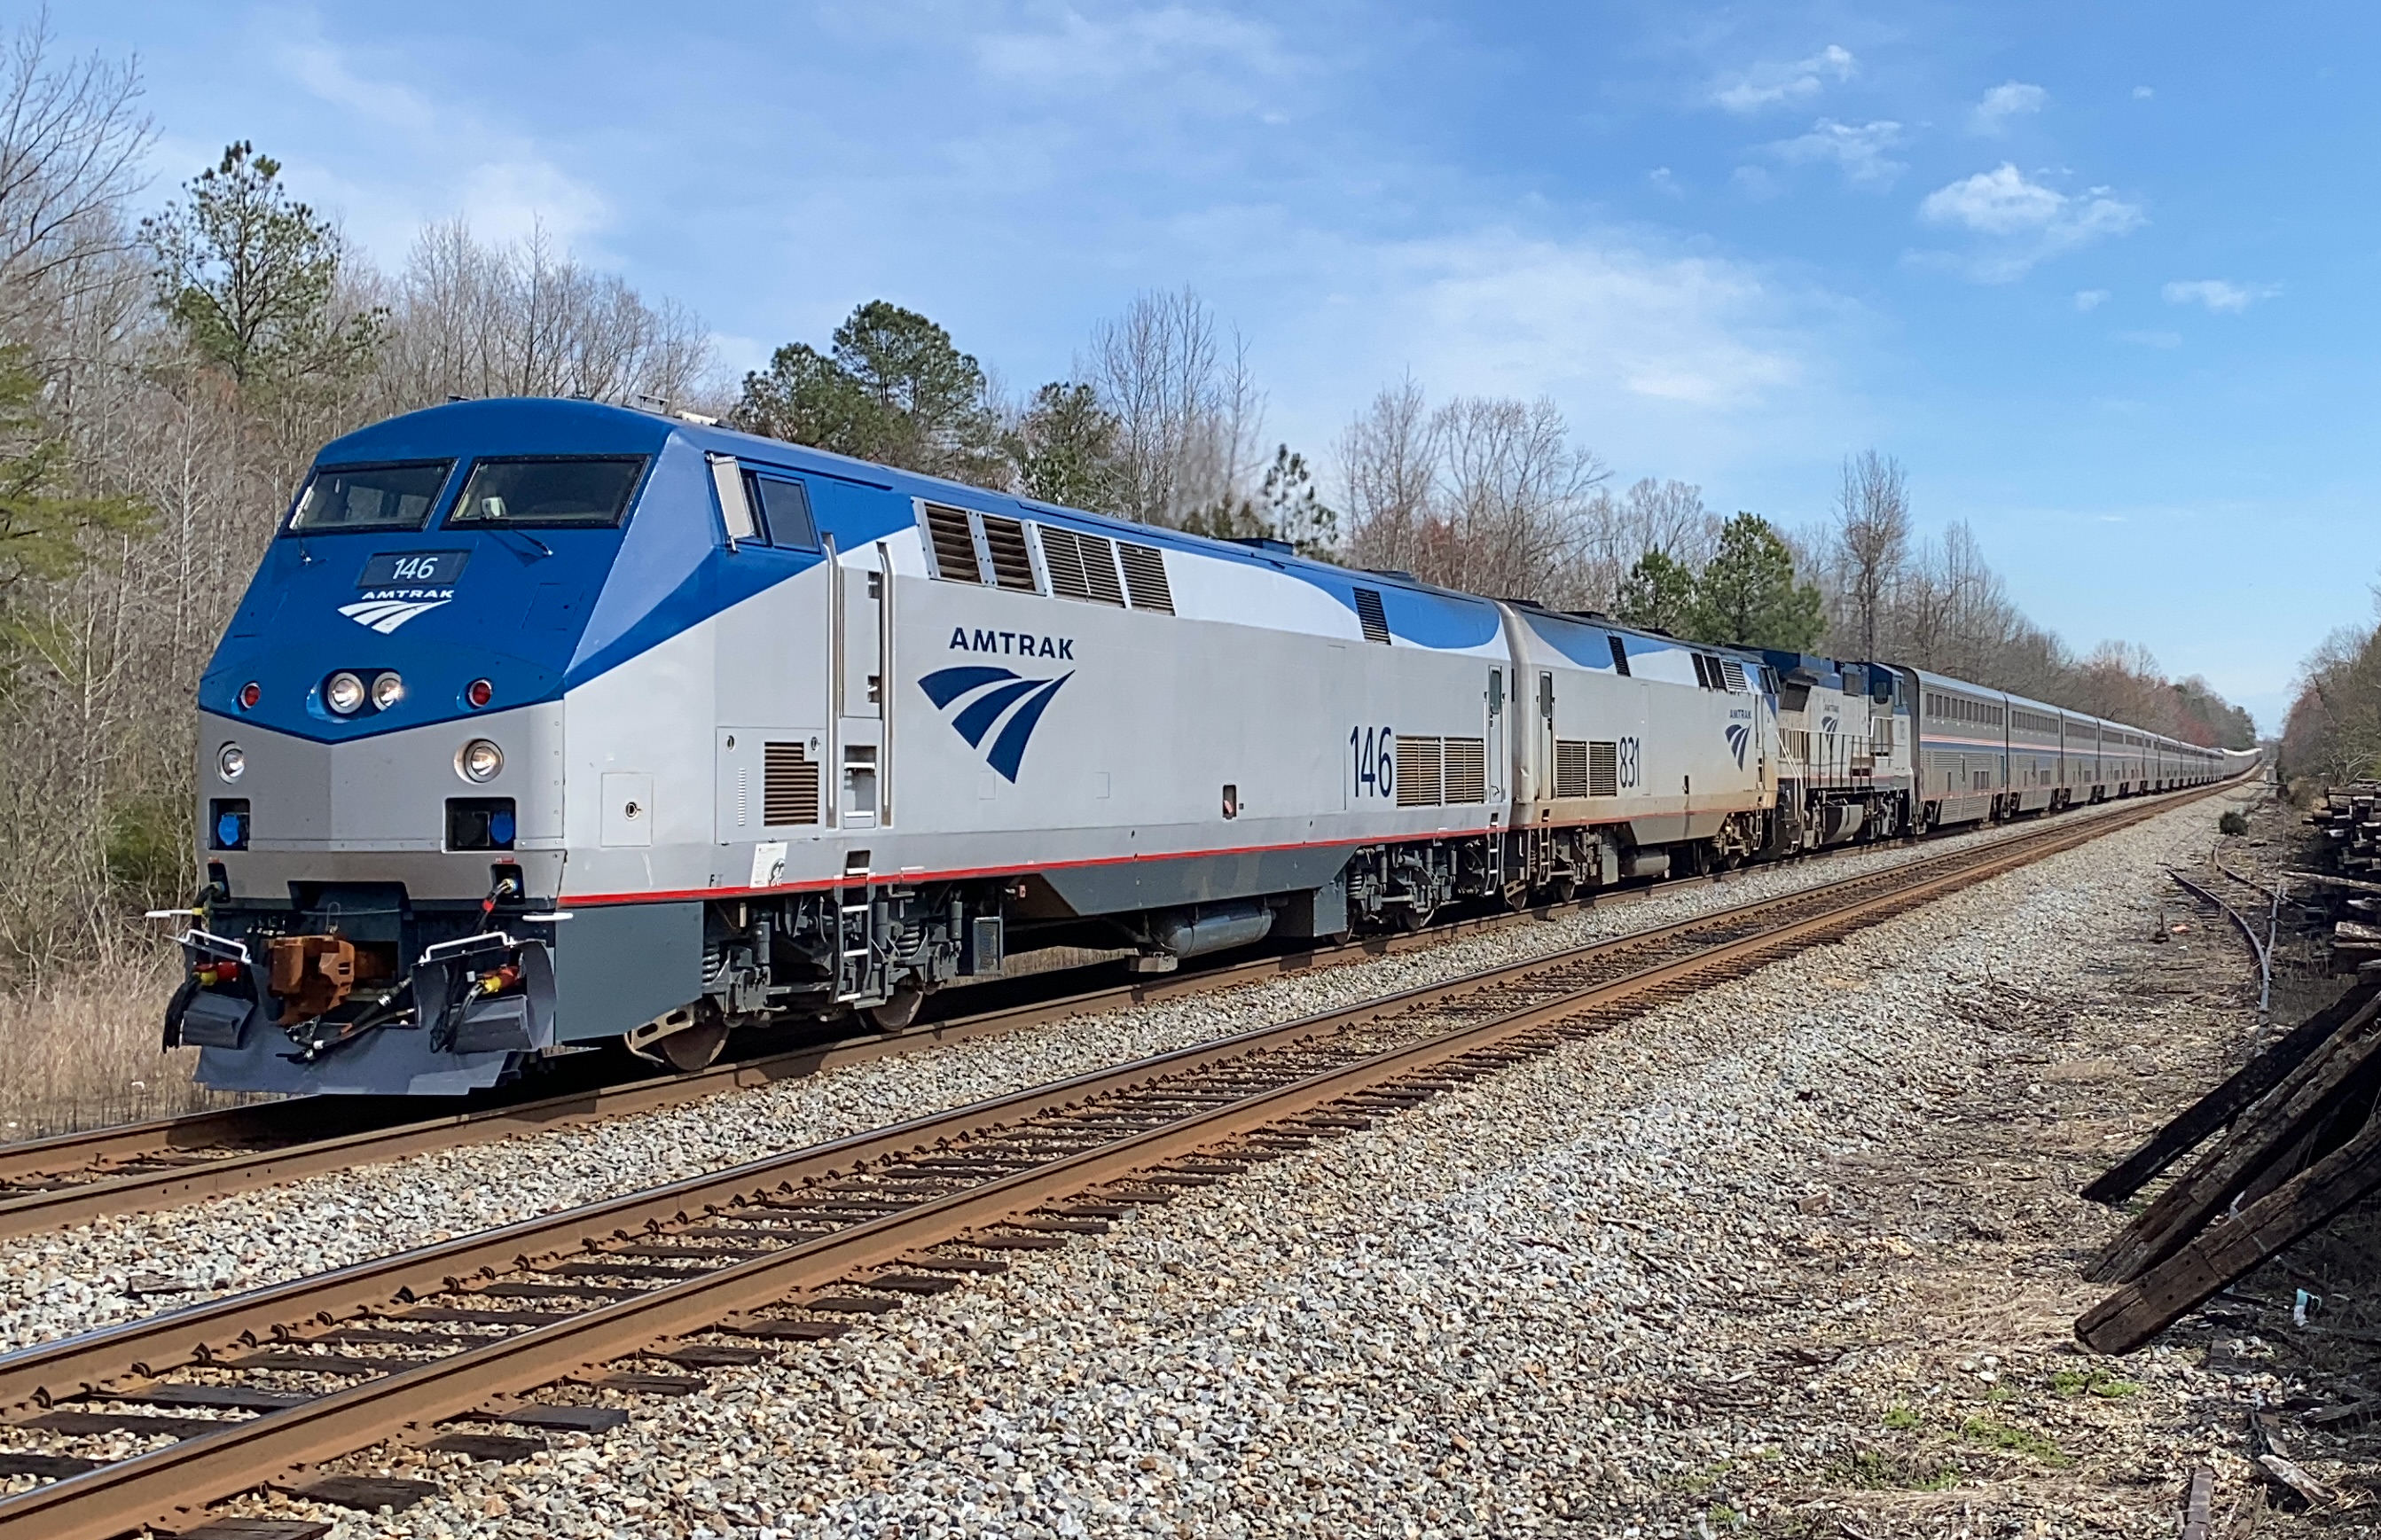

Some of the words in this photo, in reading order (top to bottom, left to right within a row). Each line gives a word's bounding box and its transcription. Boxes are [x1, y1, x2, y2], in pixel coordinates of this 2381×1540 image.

[392, 557, 439, 580] 146
[361, 590, 455, 600] AMTRAK
[949, 626, 1074, 661] AMTRAK
[1729, 708, 1752, 720] AMTRAK
[1350, 725, 1393, 798] 146
[1619, 737, 1640, 788] 831
